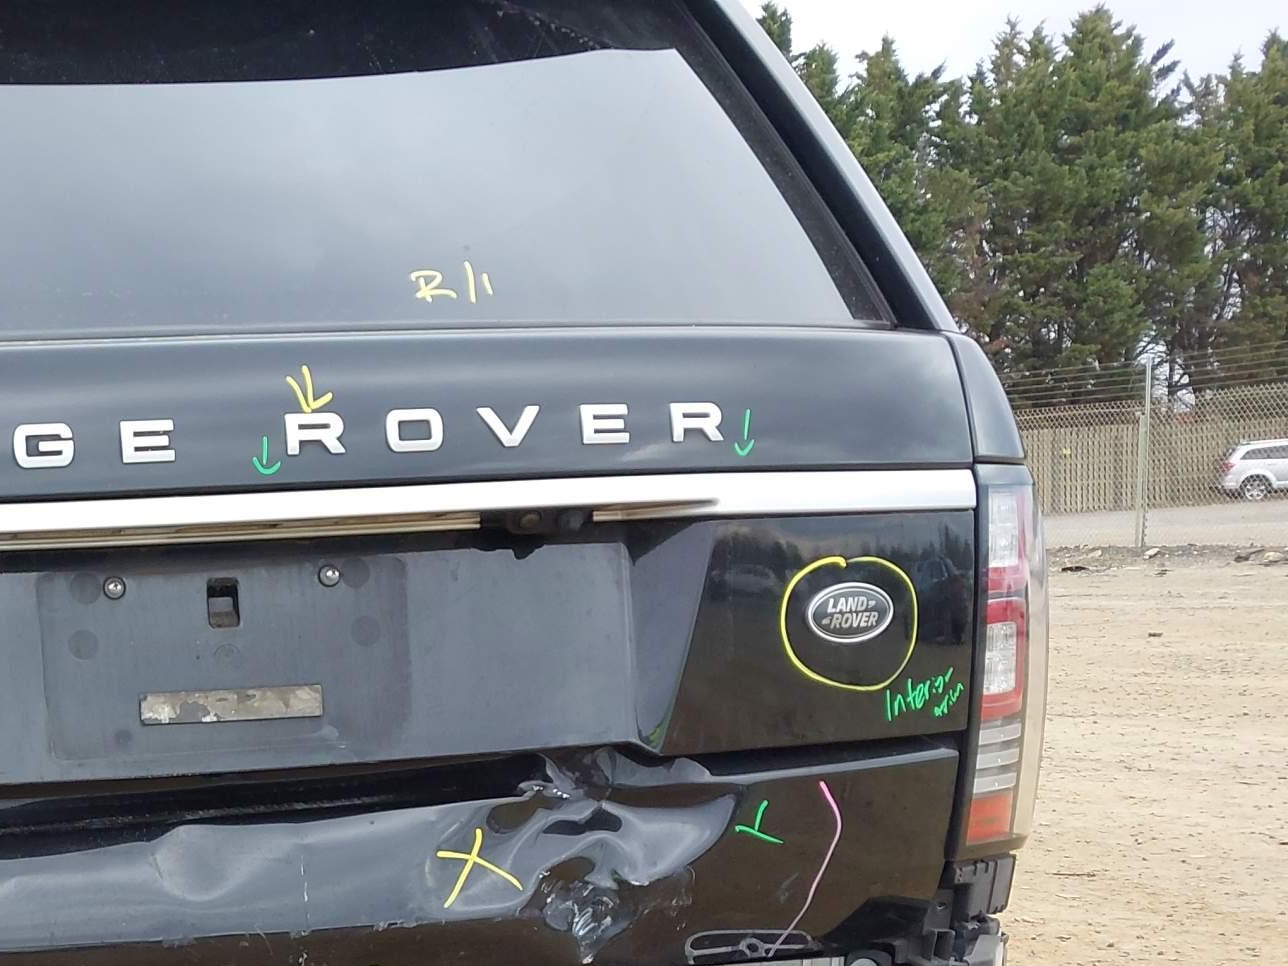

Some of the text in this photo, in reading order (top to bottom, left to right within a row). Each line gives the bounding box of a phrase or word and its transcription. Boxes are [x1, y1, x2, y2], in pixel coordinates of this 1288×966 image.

[285, 400, 724, 457] ROVER
[827, 596, 867, 613] LAND
[830, 612, 878, 628] ROVER
